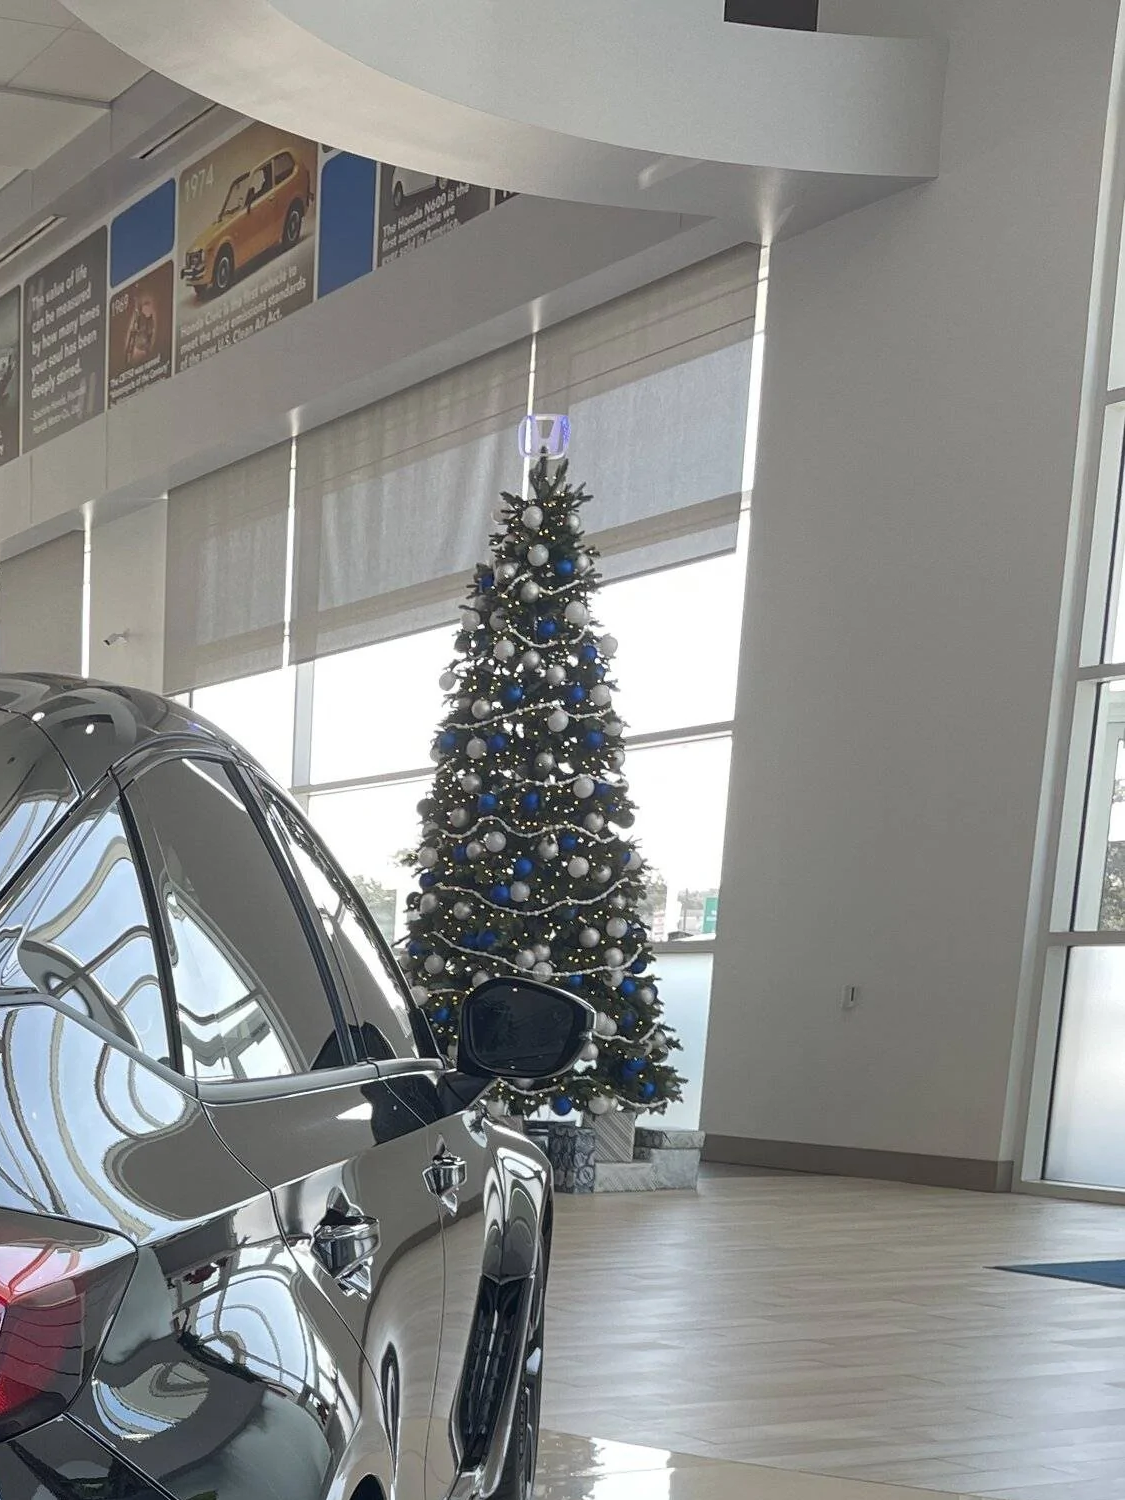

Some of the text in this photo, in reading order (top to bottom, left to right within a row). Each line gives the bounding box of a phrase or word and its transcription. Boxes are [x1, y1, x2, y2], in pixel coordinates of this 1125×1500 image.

[184, 163, 214, 202] 1974
[382, 204, 455, 253] first automobile we
[398, 206, 423, 230] Honda
[424, 192, 447, 216] N600
[31, 296, 45, 312] The
[46, 282, 65, 303] value
[75, 264, 88, 284] life
[31, 281, 92, 334] can be measured
[31, 304, 101, 358] by how many times
[180, 335, 199, 355] meet
[231, 299, 267, 328] emissions
[268, 275, 307, 308] standards
[31, 329, 98, 383] your soul has been
